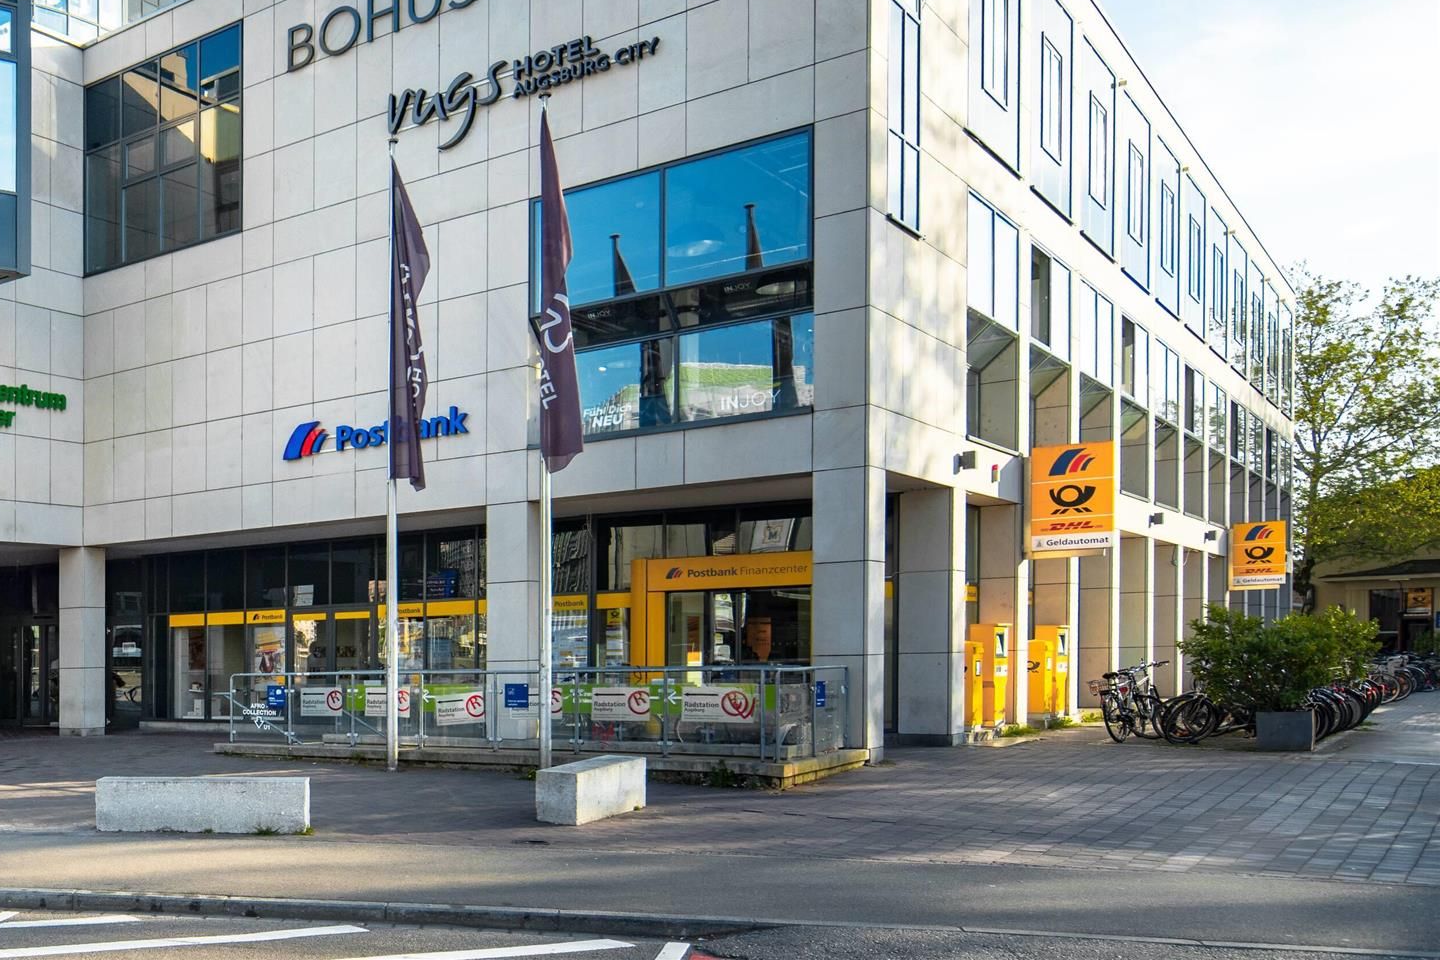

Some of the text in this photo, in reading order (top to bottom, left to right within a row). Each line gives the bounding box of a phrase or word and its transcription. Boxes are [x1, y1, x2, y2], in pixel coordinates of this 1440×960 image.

[512, 35, 600, 81] HOTEL
[511, 36, 661, 100] AUGSBURG CITY
[720, 389, 781, 411] INJOY
[583, 405, 632, 418] Fühl Dich
[592, 414, 624, 428] NEU
[336, 405, 470, 452] Postank
[1049, 521, 1095, 531] DHL
[1046, 537, 1109, 547] Geldautomat
[687, 565, 809, 578] Postbank Finanzcenter
[554, 599, 585, 607] Postbank
